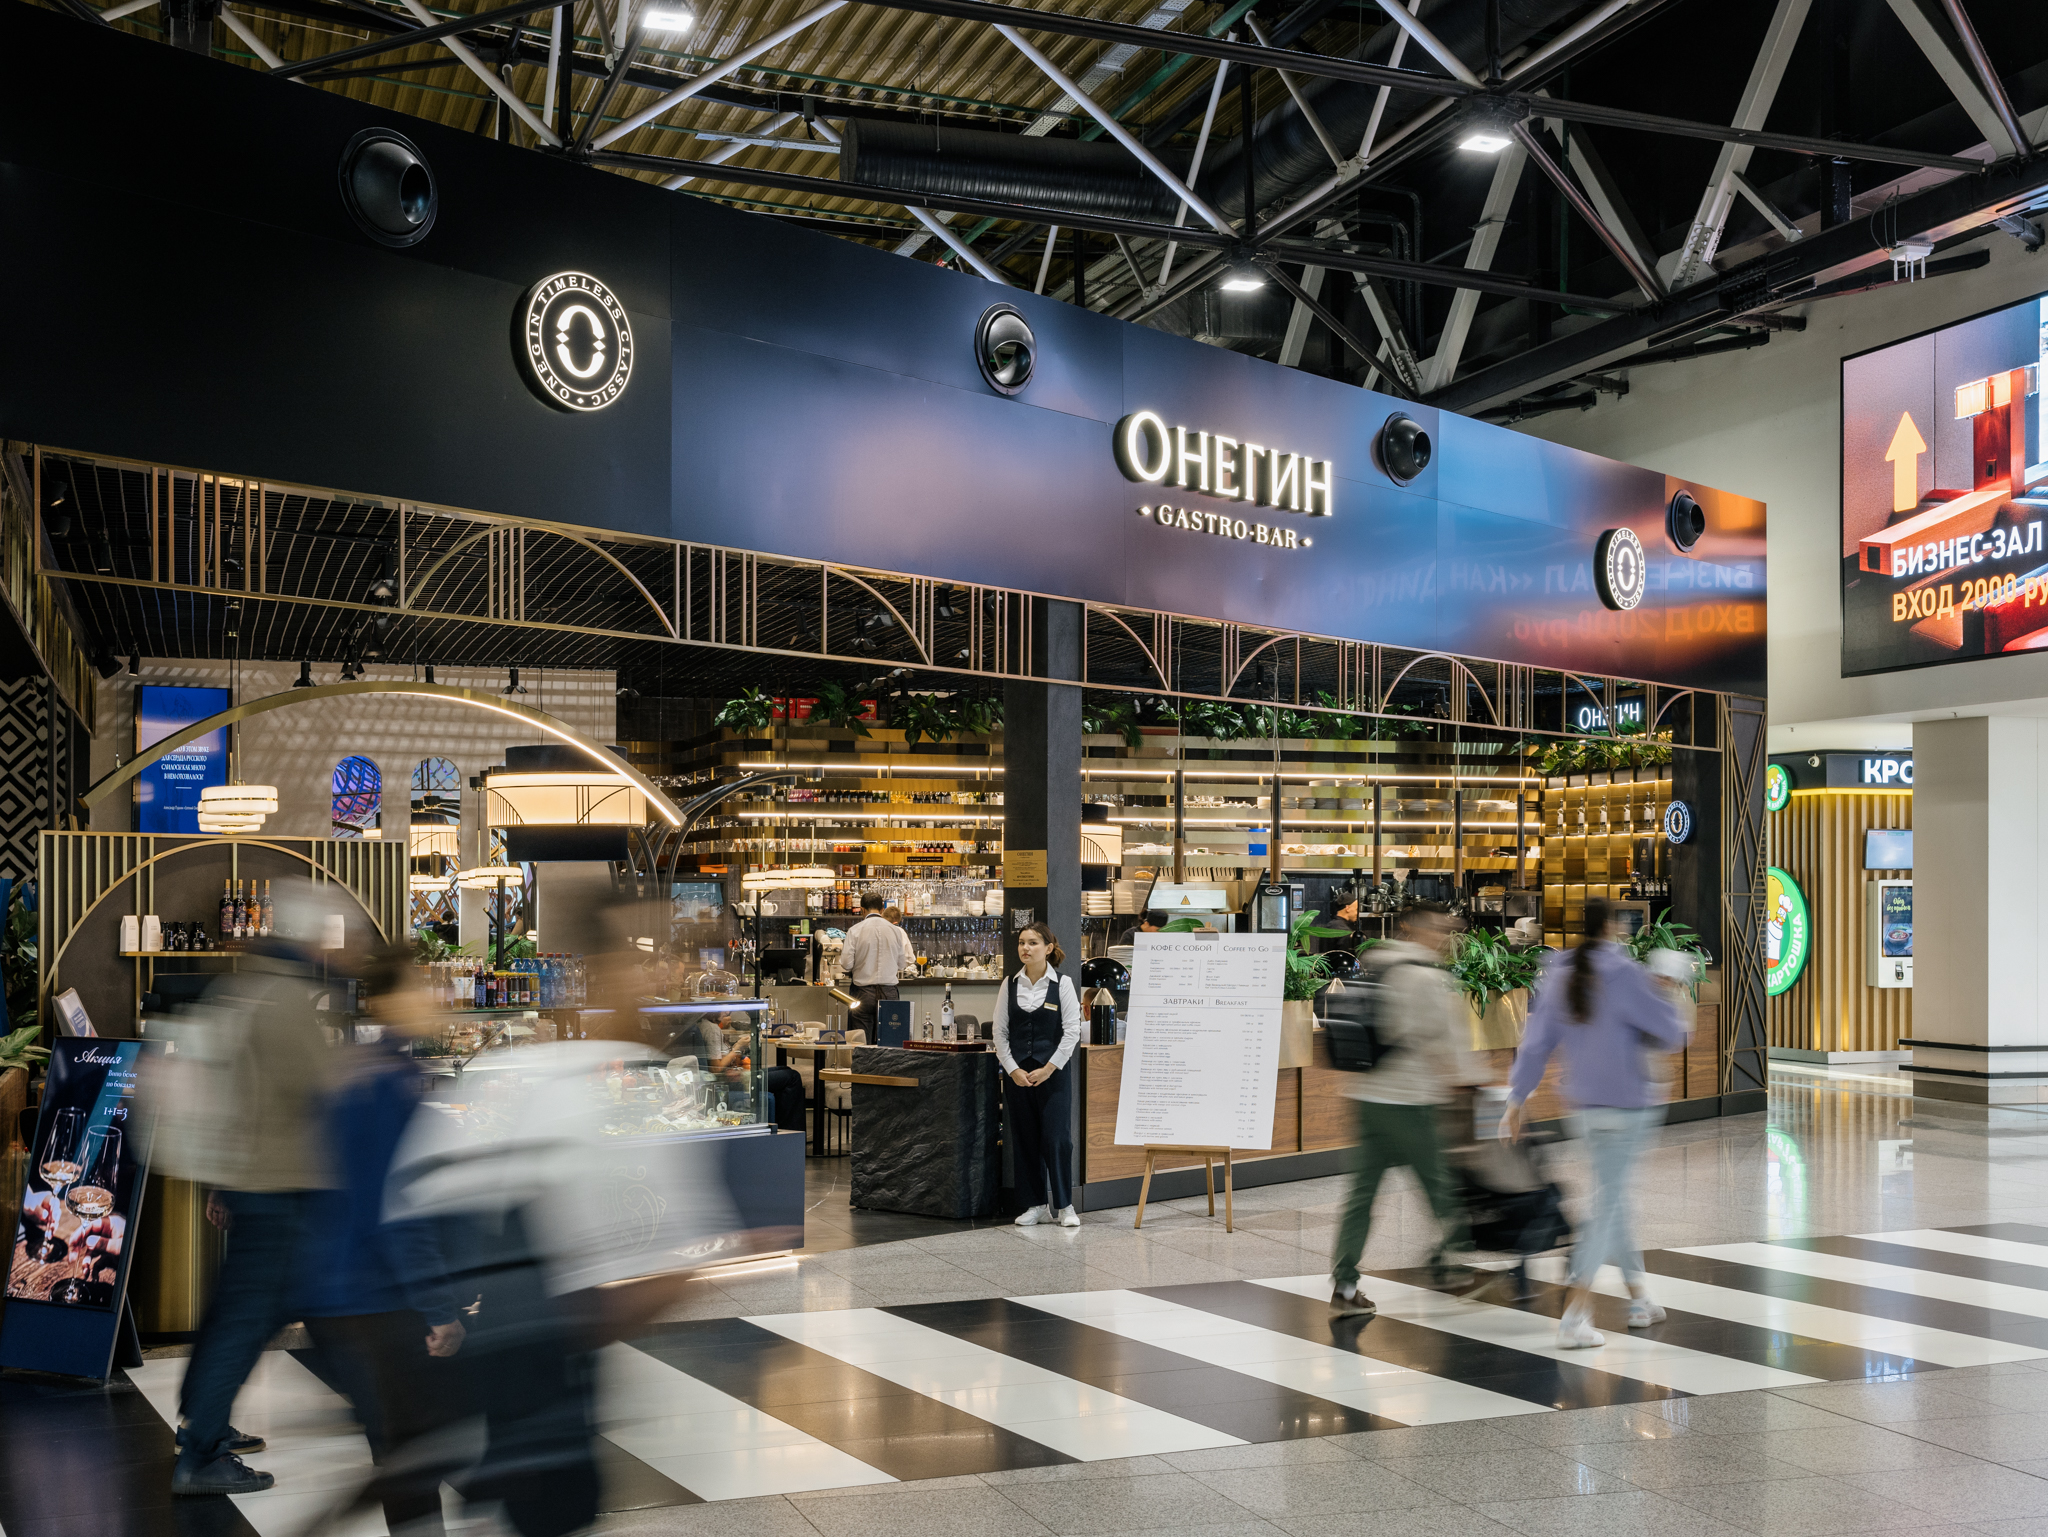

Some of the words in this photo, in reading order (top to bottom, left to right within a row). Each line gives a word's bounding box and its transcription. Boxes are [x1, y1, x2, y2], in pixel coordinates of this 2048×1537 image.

[538, 276, 622, 319] TIMELESS
[530, 312, 571, 400] ONEGIN
[591, 330, 631, 406] CLASSIC
[1893, 520, 2043, 578] БИЗНЕС-ЗАЛ
[1893, 583, 1954, 622] ВХОД
[1960, 573, 2016, 611] 2000
[1150, 944, 1173, 952] КОФЕ
[1175, 944, 1181, 952] С
[1183, 944, 1212, 952] СОБОЙ
[1163, 998, 1204, 1006] ЗАВТРАКИ
[74, 1047, 123, 1066] Акция
